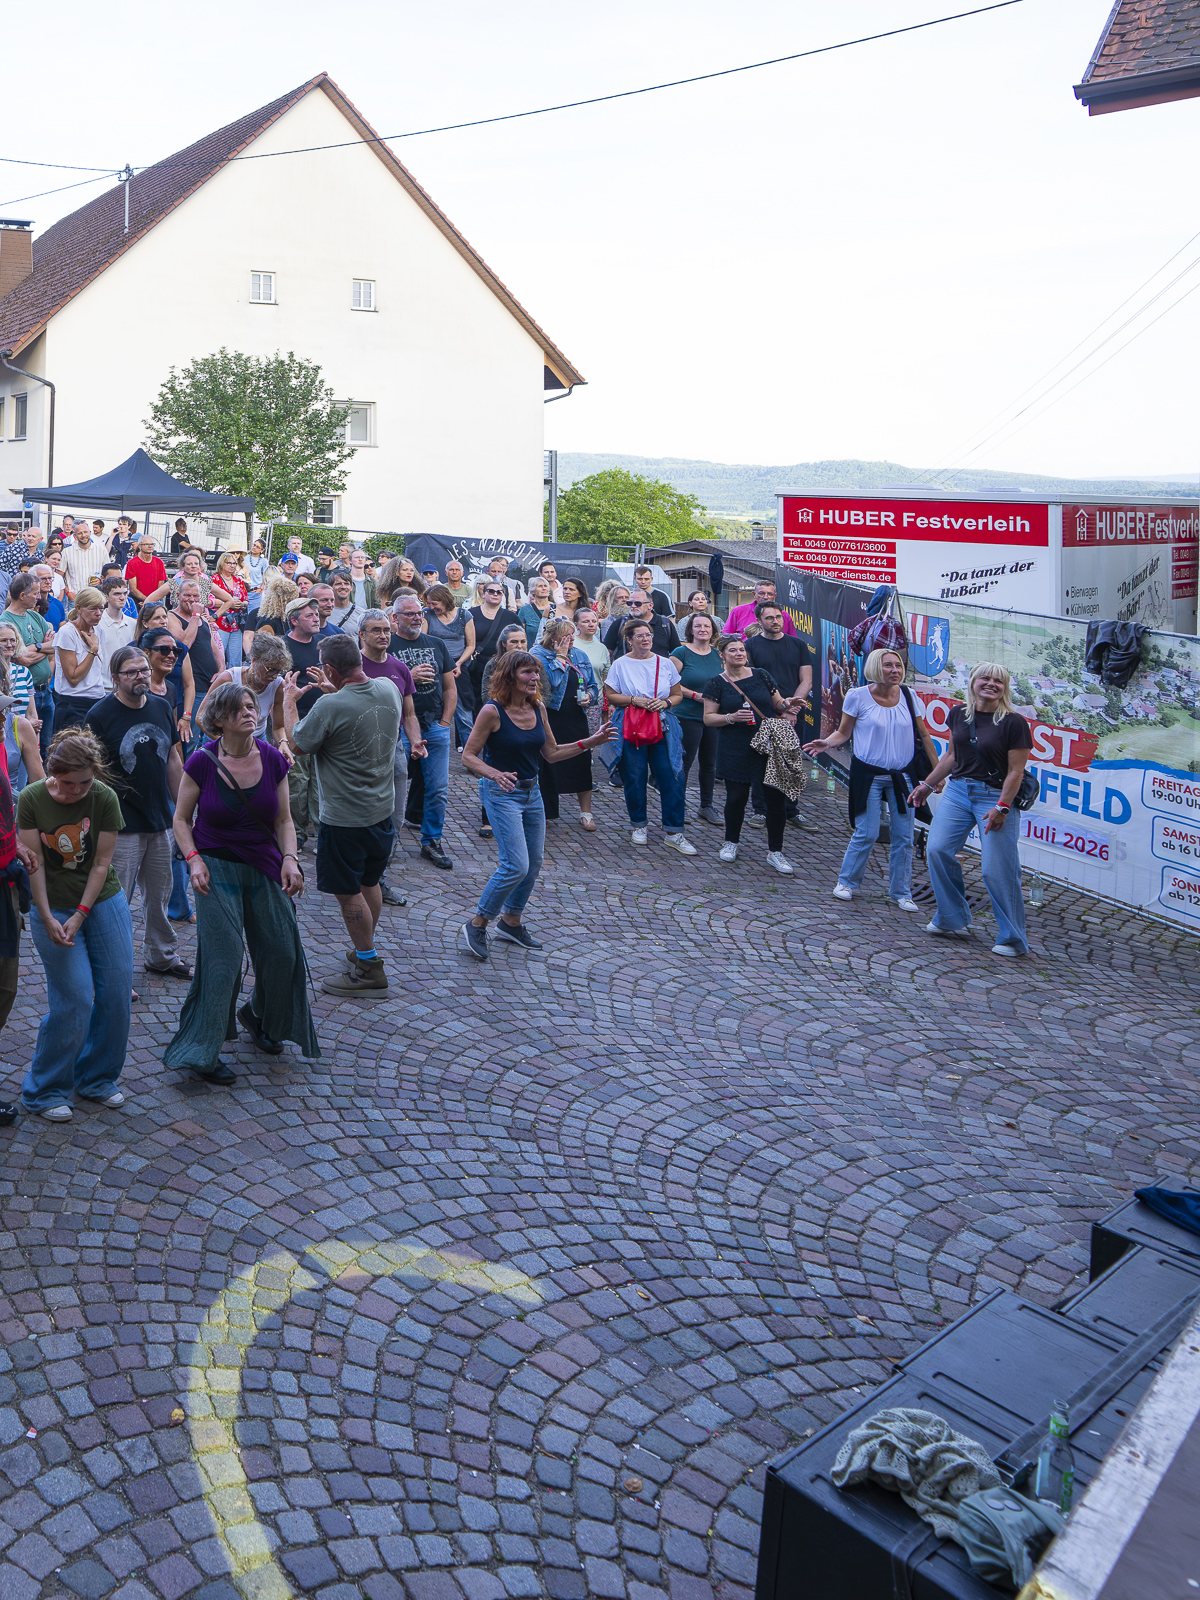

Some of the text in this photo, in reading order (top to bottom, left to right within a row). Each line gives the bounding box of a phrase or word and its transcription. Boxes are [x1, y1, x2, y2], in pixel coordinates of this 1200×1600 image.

[819, 509, 896, 526] HUBER
[903, 512, 1030, 532] Festverleih
[1096, 511, 1146, 540] HUBER
[447, 540, 469, 561] LES
[788, 538, 887, 552] Tel. 0049 (0)7761/3600
[788, 552, 804, 561] Fax
[829, 555, 887, 566] (0)7761/3444
[971, 563, 1006, 579] tanzt
[1009, 561, 1034, 574] der
[1070, 586, 1099, 599] Bierwagen
[1070, 602, 1100, 616] Kühlwagen
[1152, 777, 1200, 797] FREITAG
[1152, 789, 1183, 805] 19:00
[1024, 820, 1110, 861] Juli 2026
[1161, 840, 1176, 851] ab
[1179, 844, 1191, 855] 16
[1171, 877, 1200, 894] SON
[1169, 890, 1185, 901] ab
